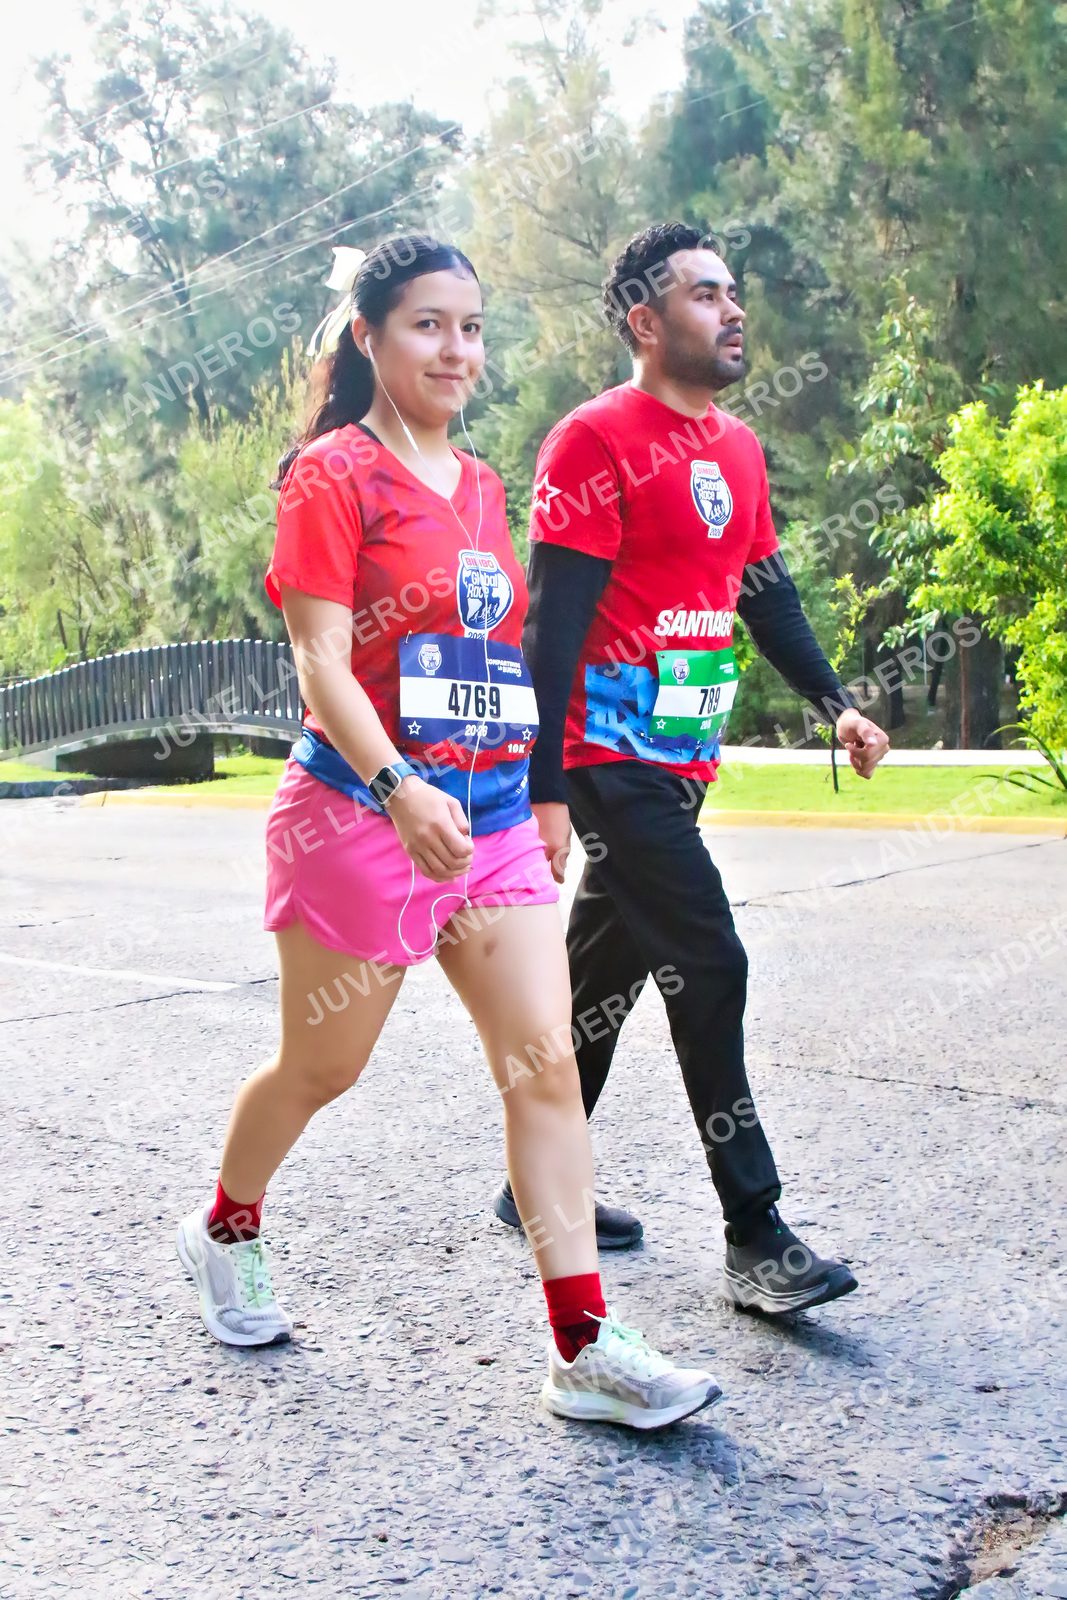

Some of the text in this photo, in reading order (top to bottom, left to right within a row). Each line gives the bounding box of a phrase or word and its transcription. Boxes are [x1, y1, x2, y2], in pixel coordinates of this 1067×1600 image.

[468, 631, 486, 640] 202
[448, 683, 501, 719] 4769
[698, 686, 721, 716] 789
[508, 743, 527, 754] 10K
